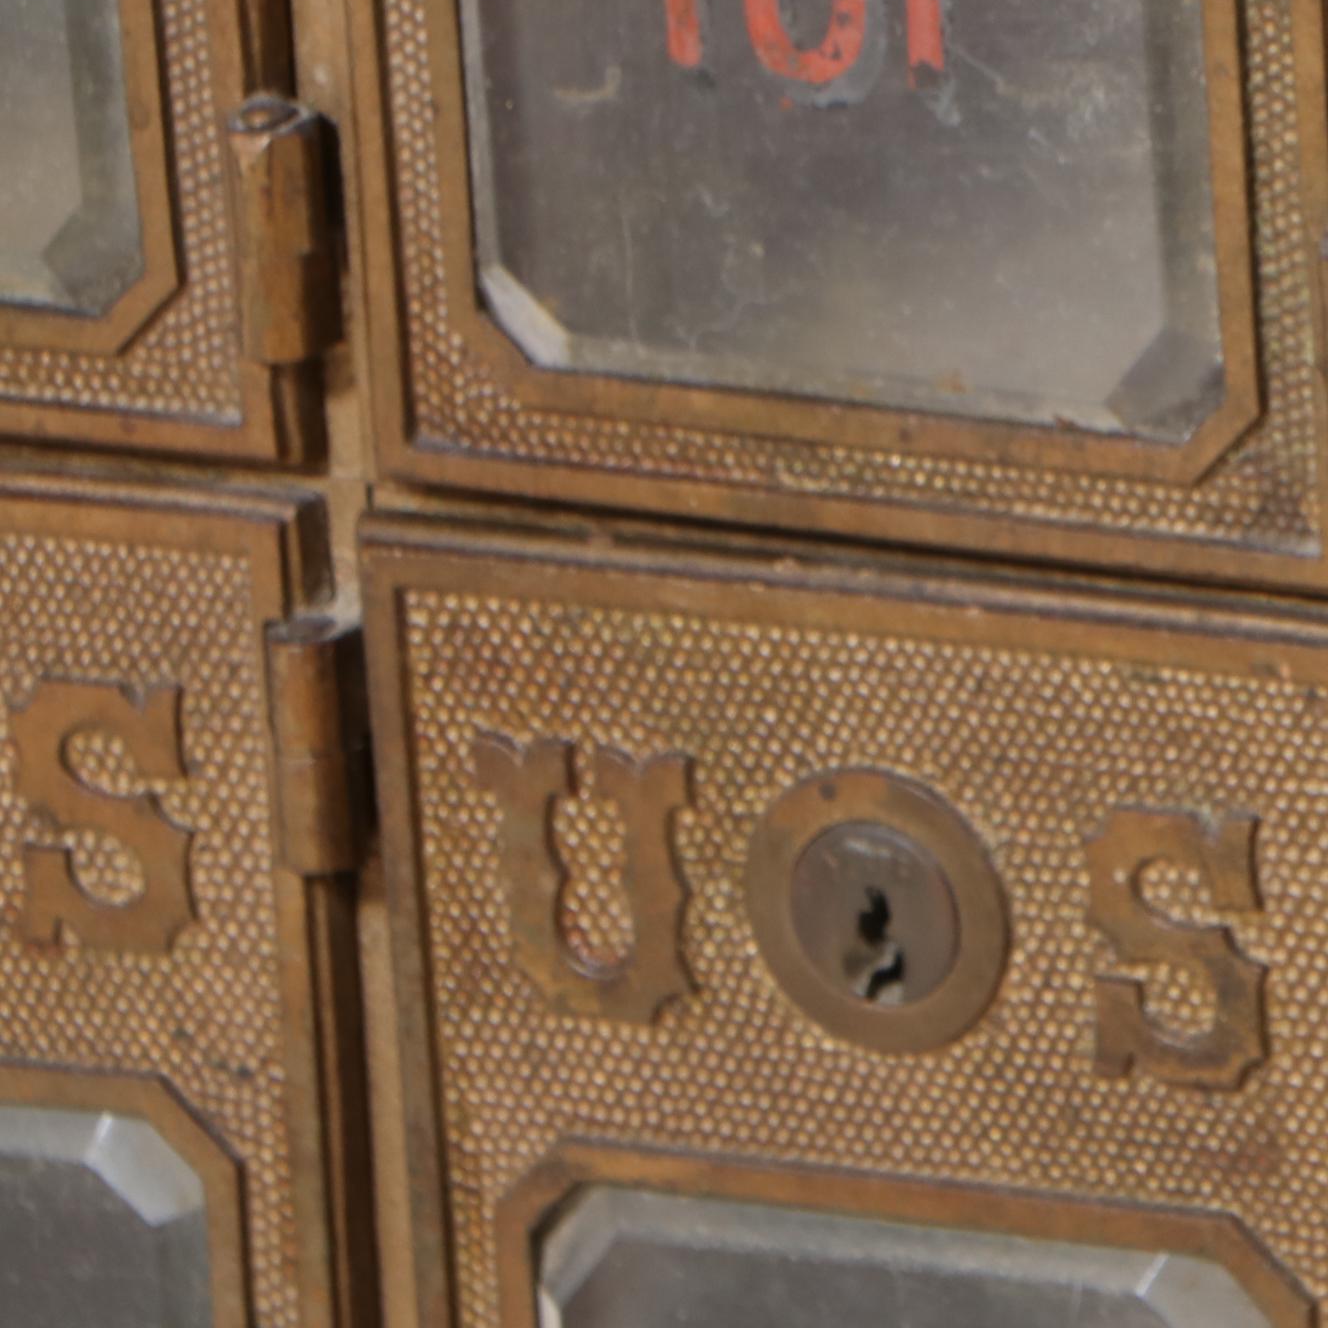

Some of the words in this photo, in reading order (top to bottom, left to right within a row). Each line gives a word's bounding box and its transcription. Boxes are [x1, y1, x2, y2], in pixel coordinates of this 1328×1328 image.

[10, 675, 198, 954] S
[474, 728, 701, 1025] U
[1085, 801, 1270, 1091] S
